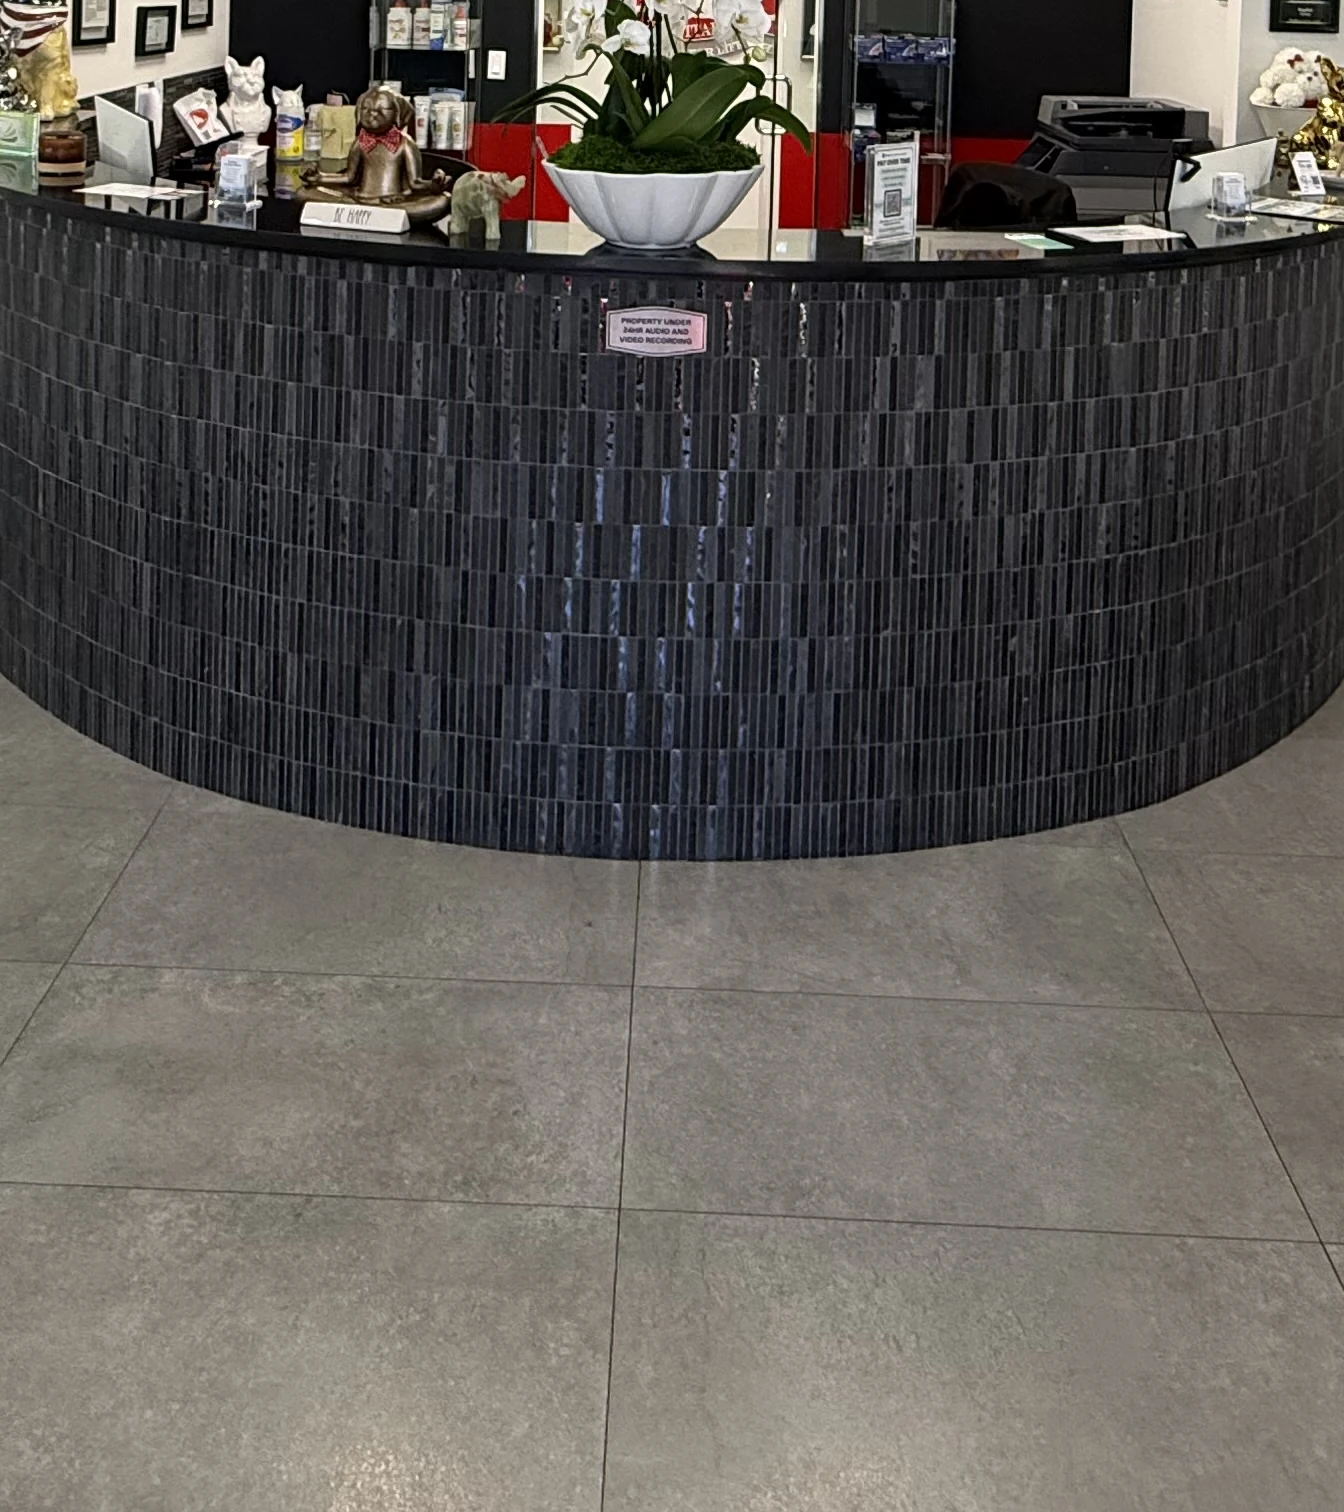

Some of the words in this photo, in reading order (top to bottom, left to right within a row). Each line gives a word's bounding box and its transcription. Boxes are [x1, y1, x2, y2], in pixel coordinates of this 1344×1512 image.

[663, 318, 691, 326] UNDER
[645, 327, 670, 335] AUDIO
[619, 336, 645, 344] VIDEO
[645, 337, 692, 345] RECORDING
